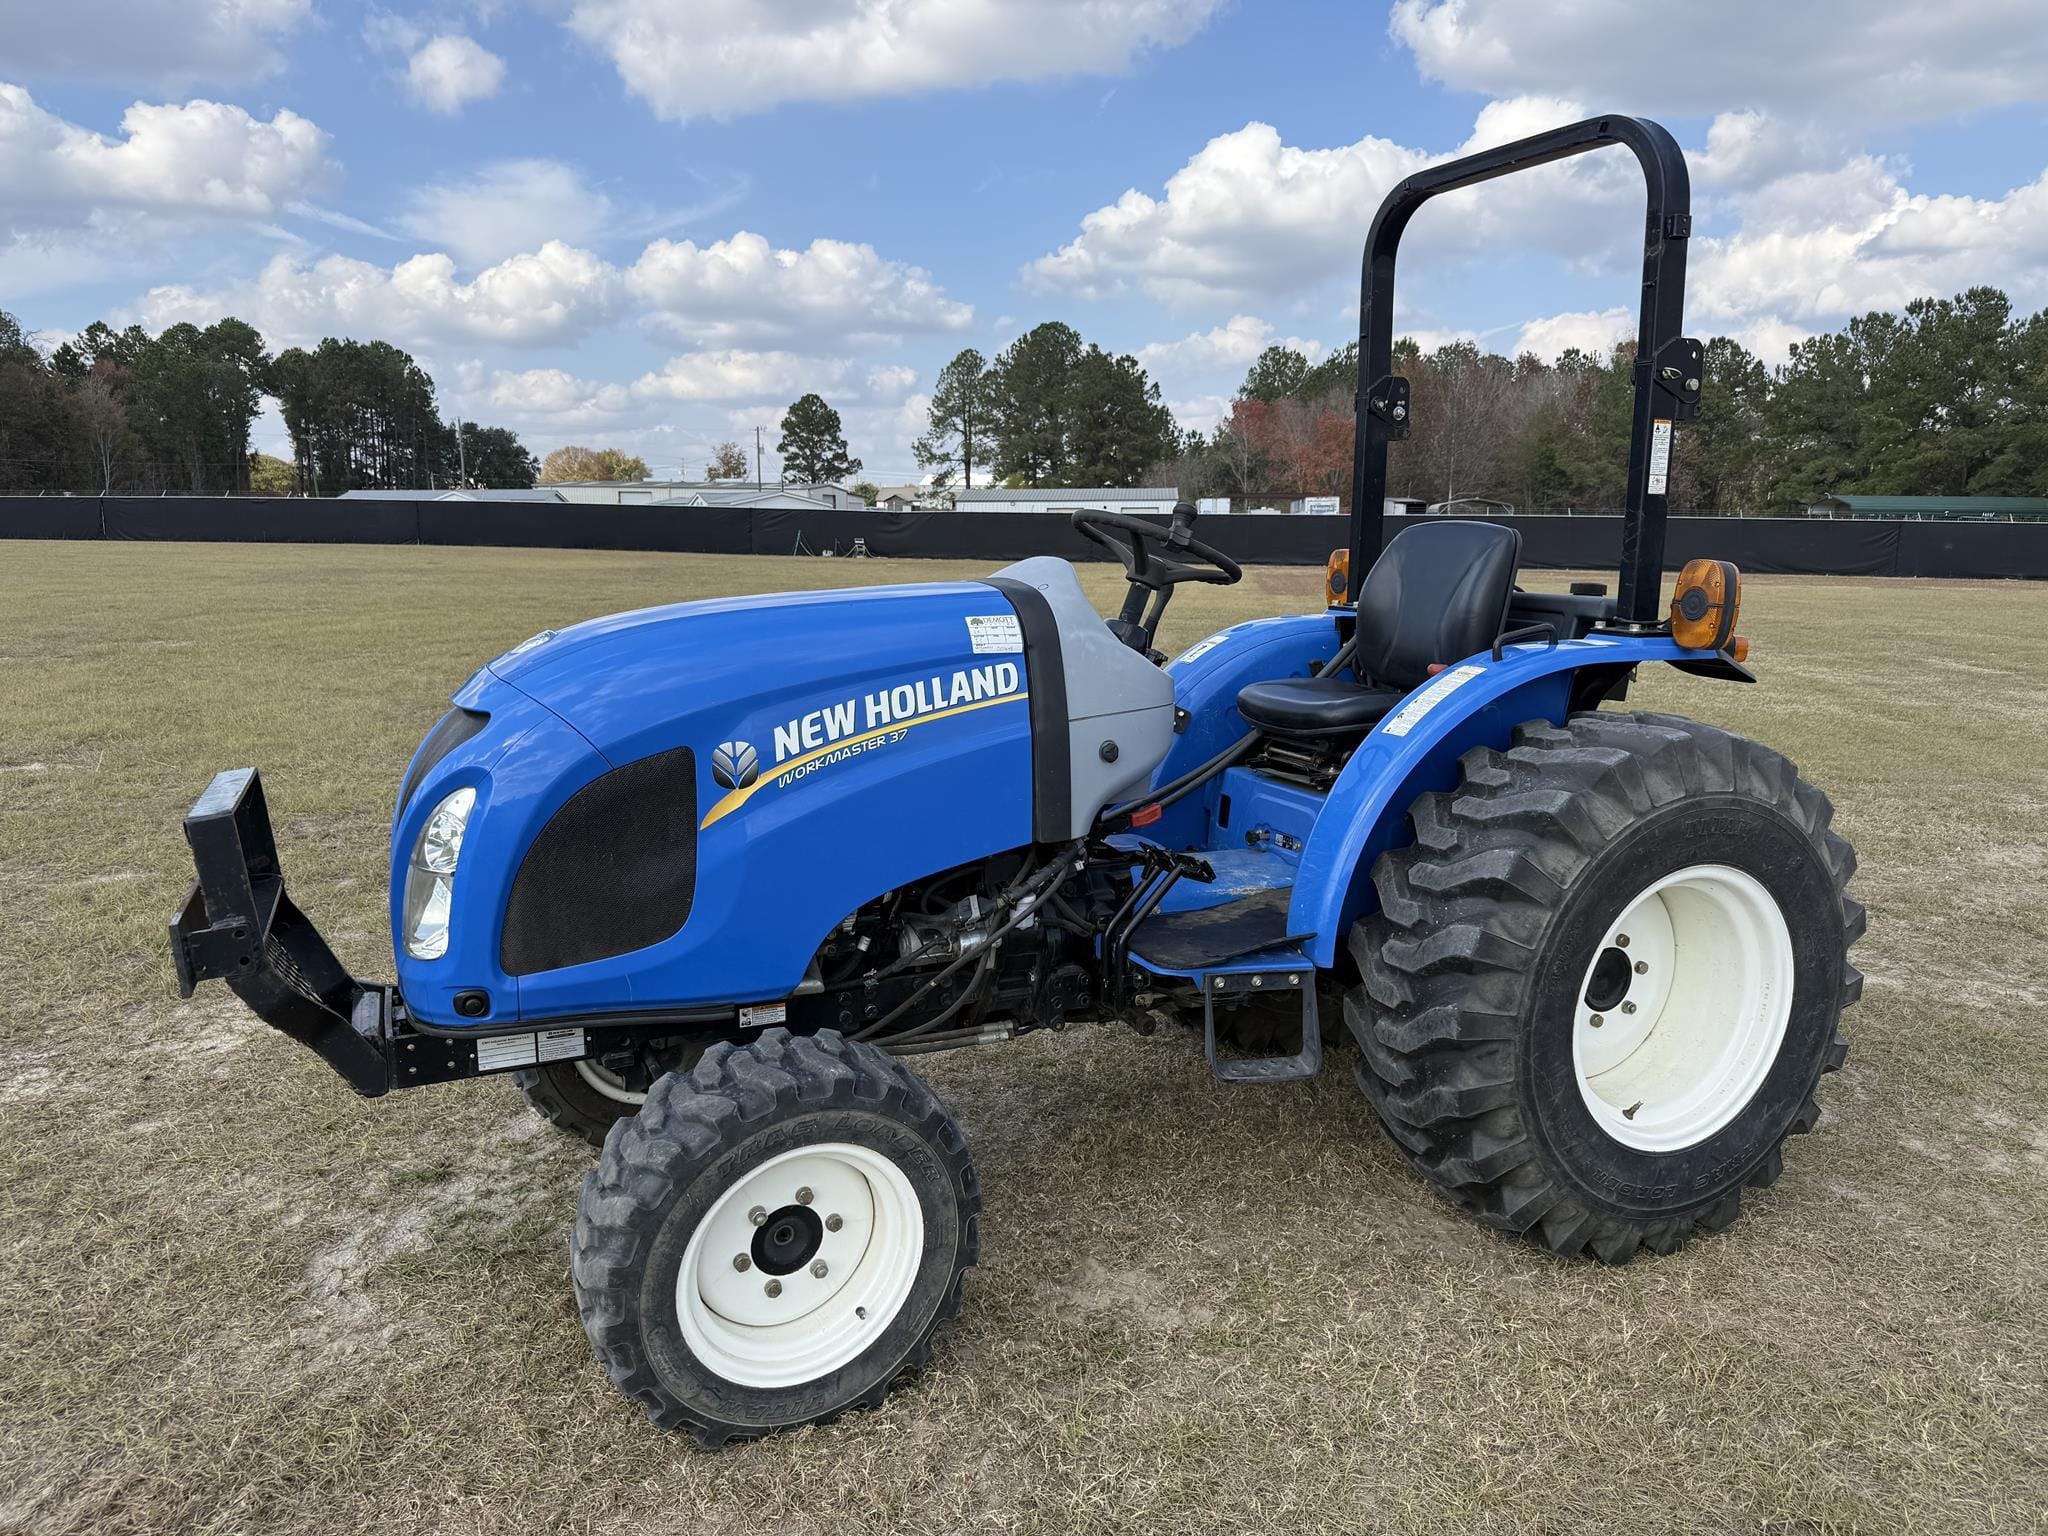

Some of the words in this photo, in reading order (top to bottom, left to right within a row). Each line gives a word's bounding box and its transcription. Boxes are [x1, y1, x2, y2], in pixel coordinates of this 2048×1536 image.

[774, 698, 857, 763] NEW
[864, 661, 1020, 728] HOLLAND
[778, 737, 887, 789] WORKMASTER
[889, 728, 909, 746] 37
[831, 1115, 944, 1183] LOADER
